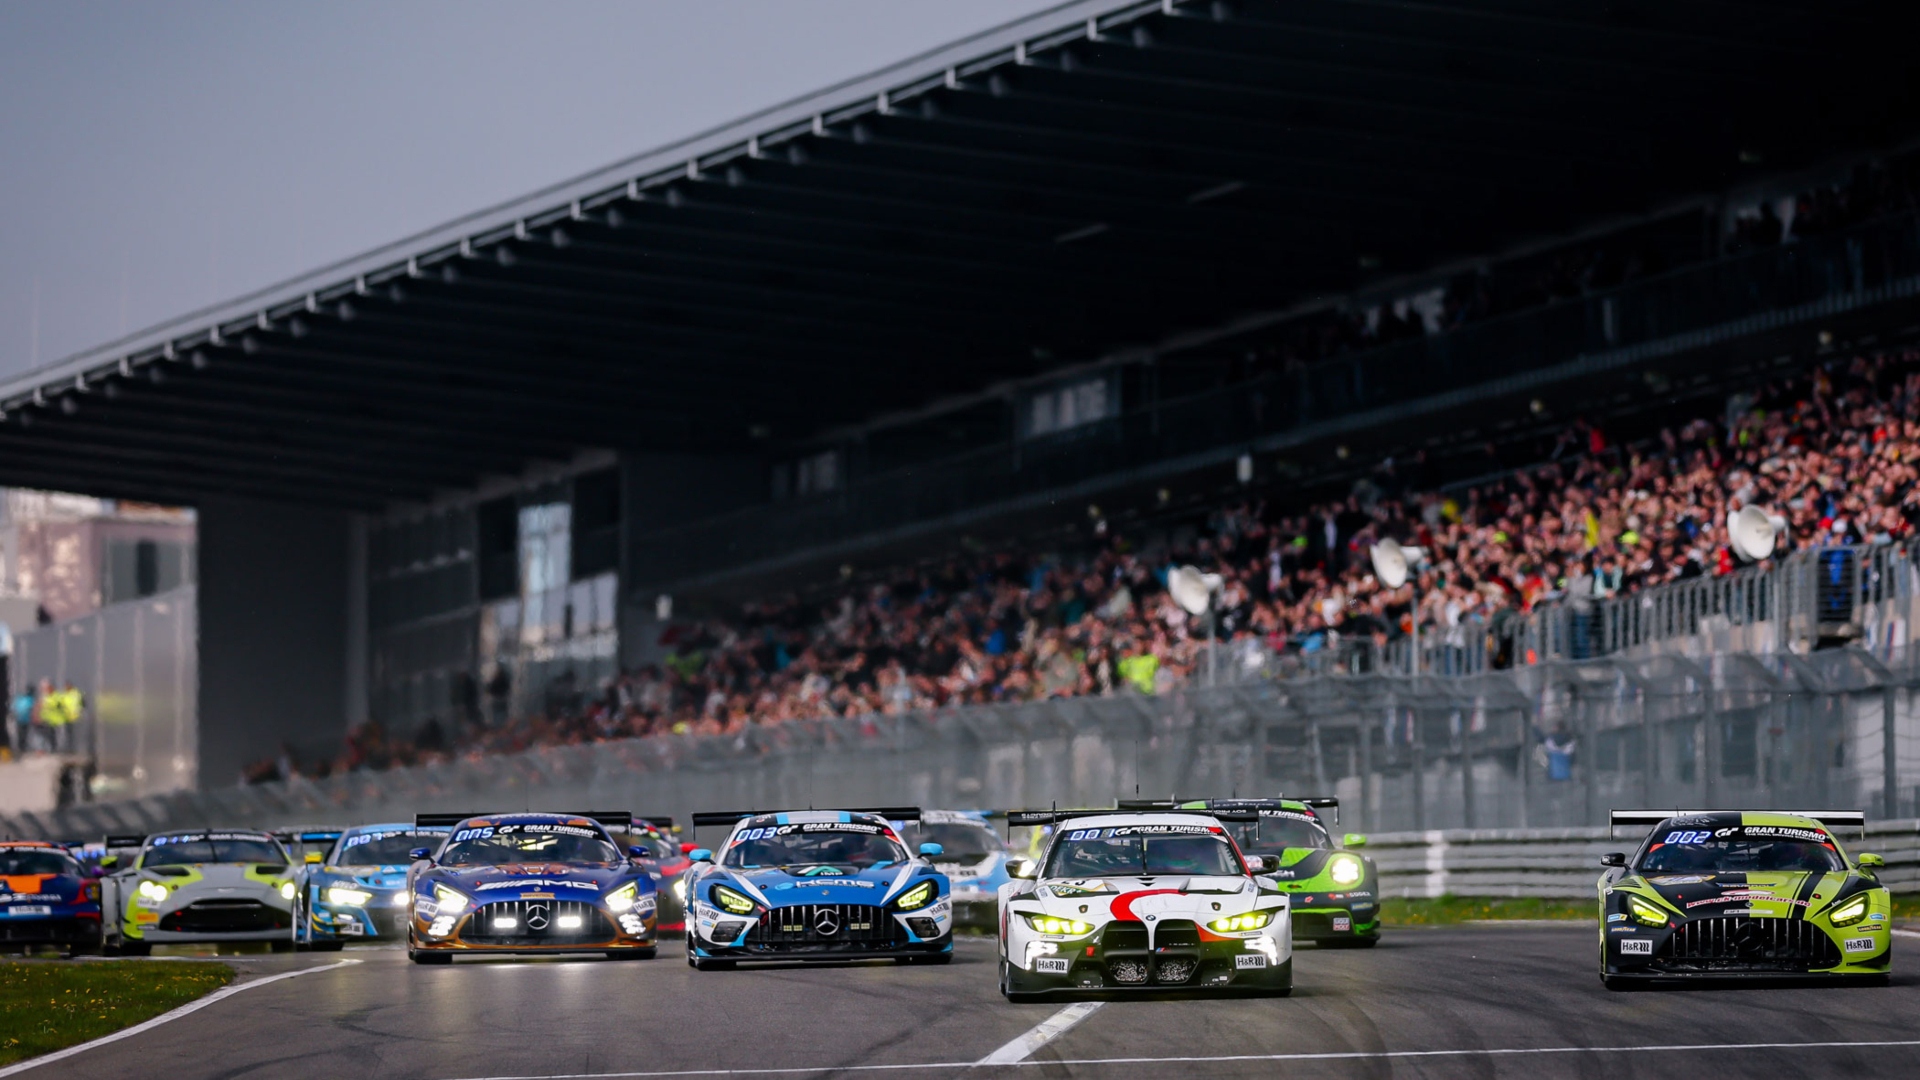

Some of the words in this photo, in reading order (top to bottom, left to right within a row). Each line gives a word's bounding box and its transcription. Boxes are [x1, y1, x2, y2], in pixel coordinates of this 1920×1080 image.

[1273, 811, 1316, 821] TURISMO
[553, 825, 595, 836] TURISMO
[833, 823, 878, 832] TURISMO
[1170, 825, 1210, 833] TURISM
[1744, 826, 1776, 834] GRAN
[1778, 827, 1826, 840] TURISMO
[735, 826, 778, 842] 003
[1664, 831, 1712, 844] 002
[516, 879, 599, 891] AMG
